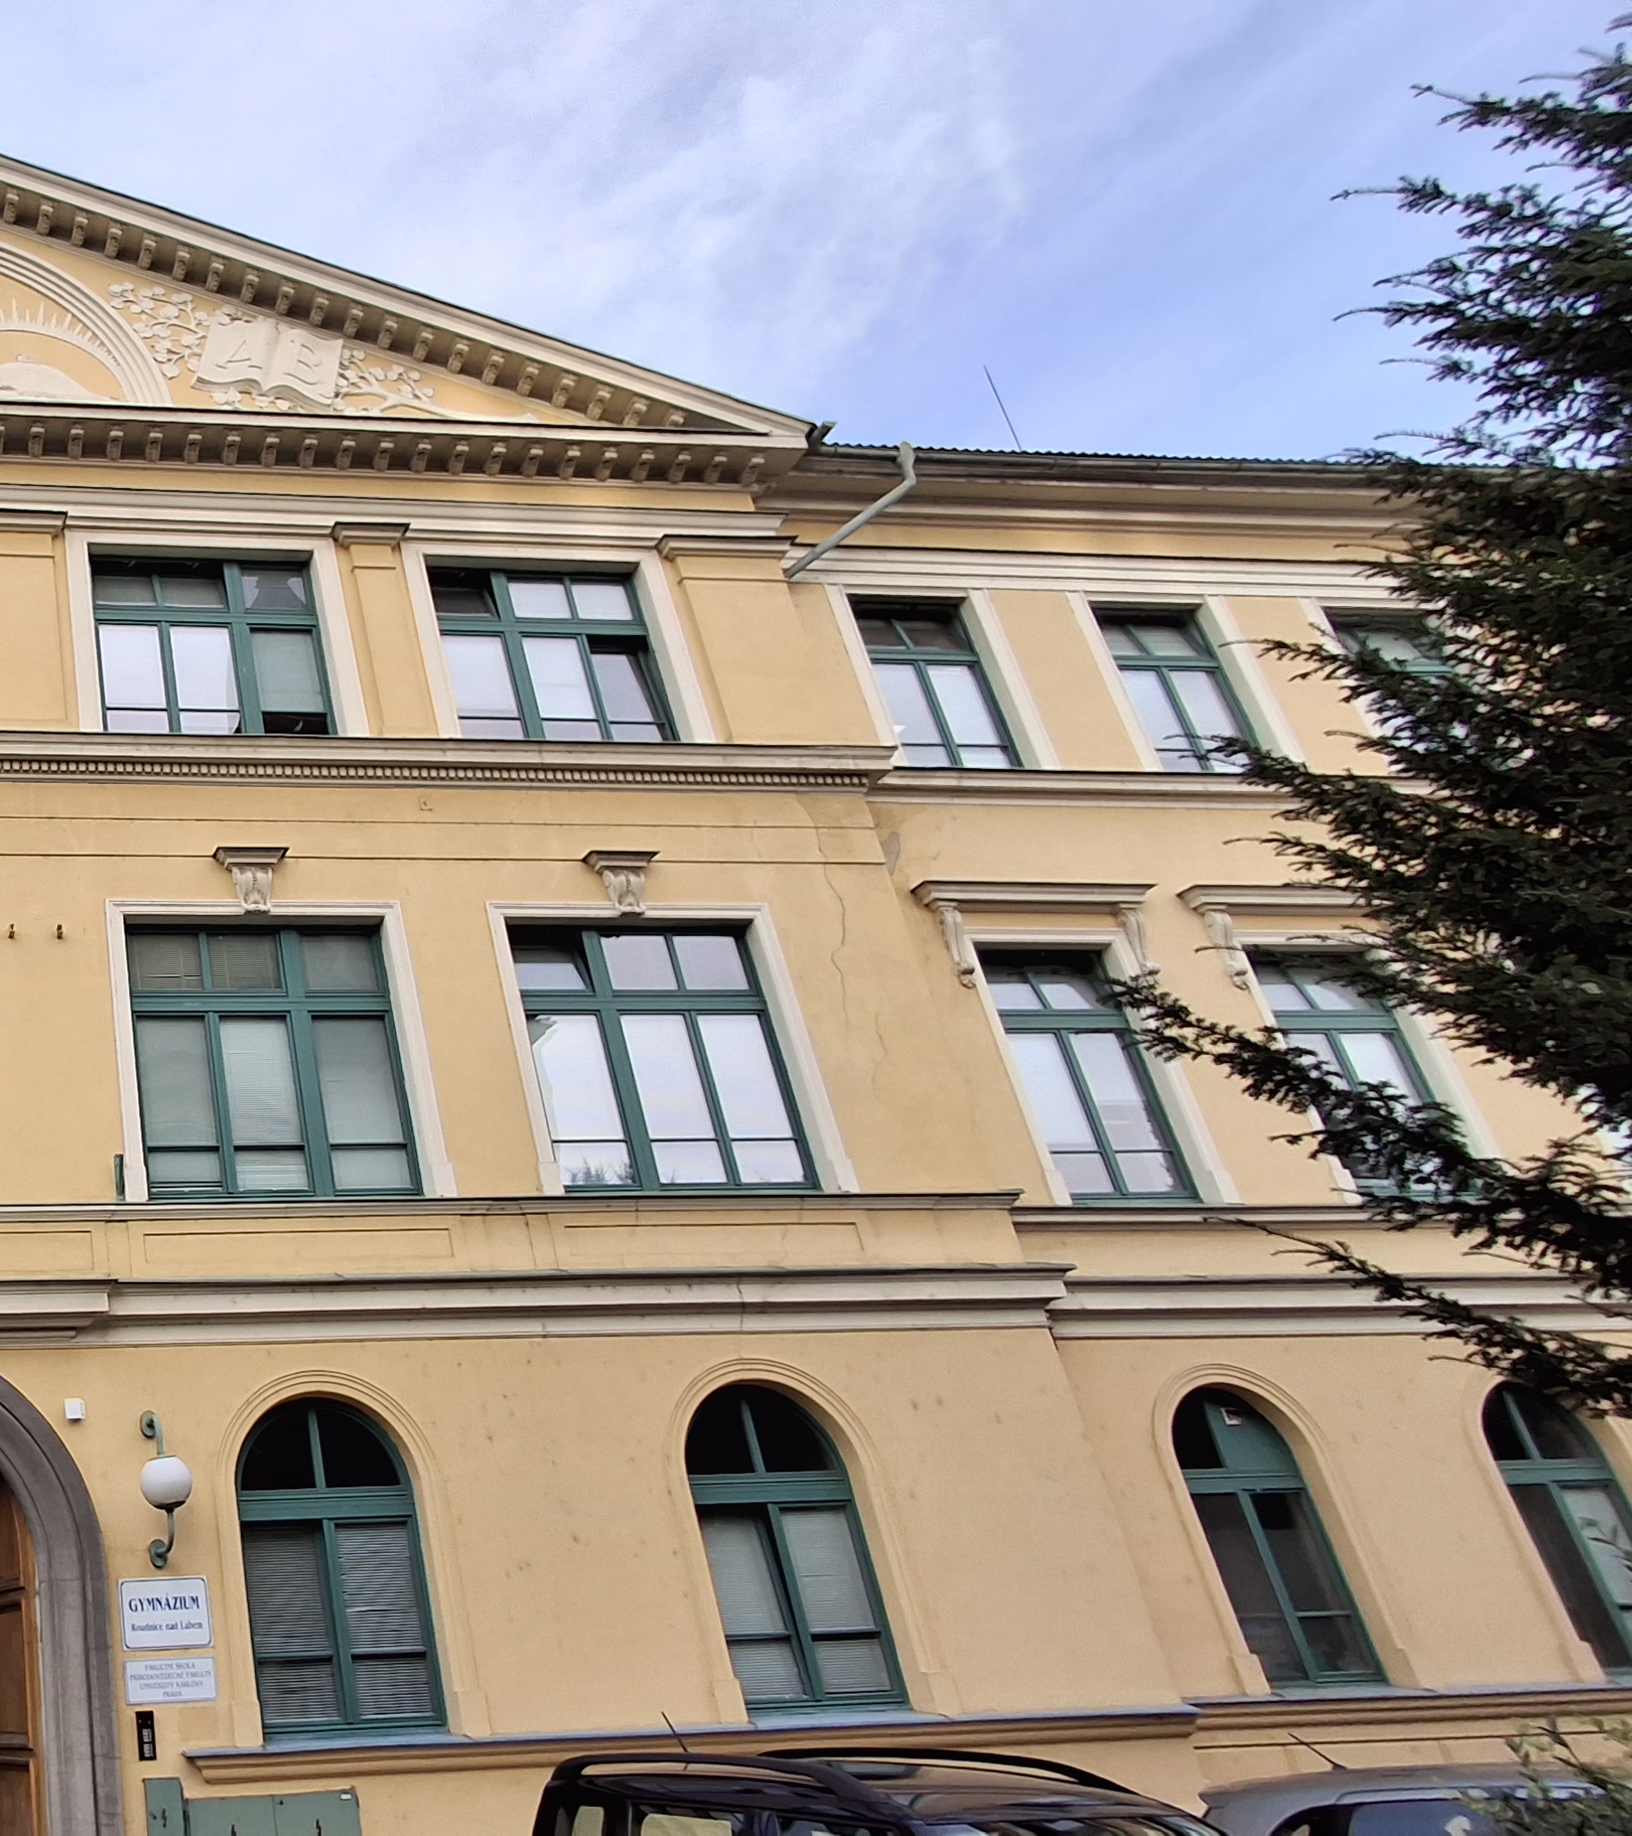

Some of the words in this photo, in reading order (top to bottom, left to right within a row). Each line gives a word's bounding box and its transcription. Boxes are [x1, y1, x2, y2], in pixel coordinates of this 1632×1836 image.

[128, 1593, 200, 1612] GYMNÁZIUM
[131, 1622, 163, 1632] Roudnice
[165, 1621, 178, 1631] nad
[180, 1620, 203, 1630] Labem
